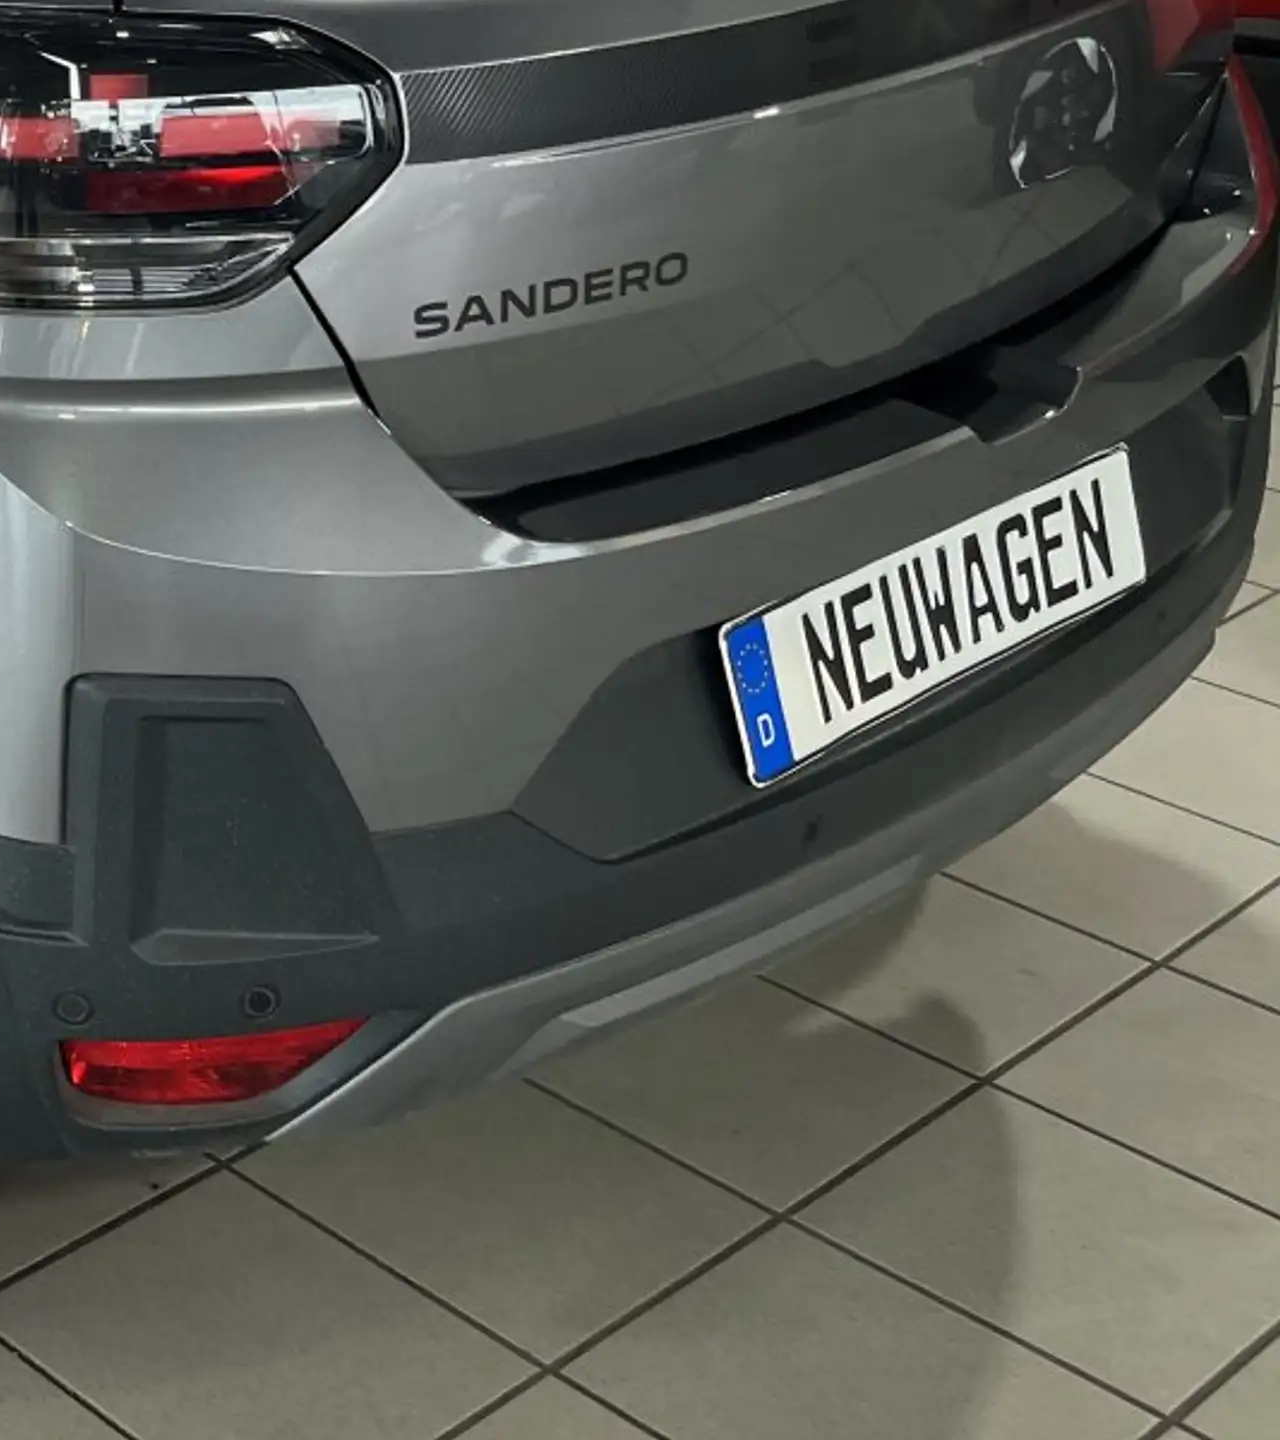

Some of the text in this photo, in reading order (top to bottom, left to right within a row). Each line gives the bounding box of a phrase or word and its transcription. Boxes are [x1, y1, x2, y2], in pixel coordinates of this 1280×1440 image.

[412, 249, 690, 339] SANDERO
[801, 477, 1116, 725] NEUWAGEN
[755, 713, 778, 748] D
